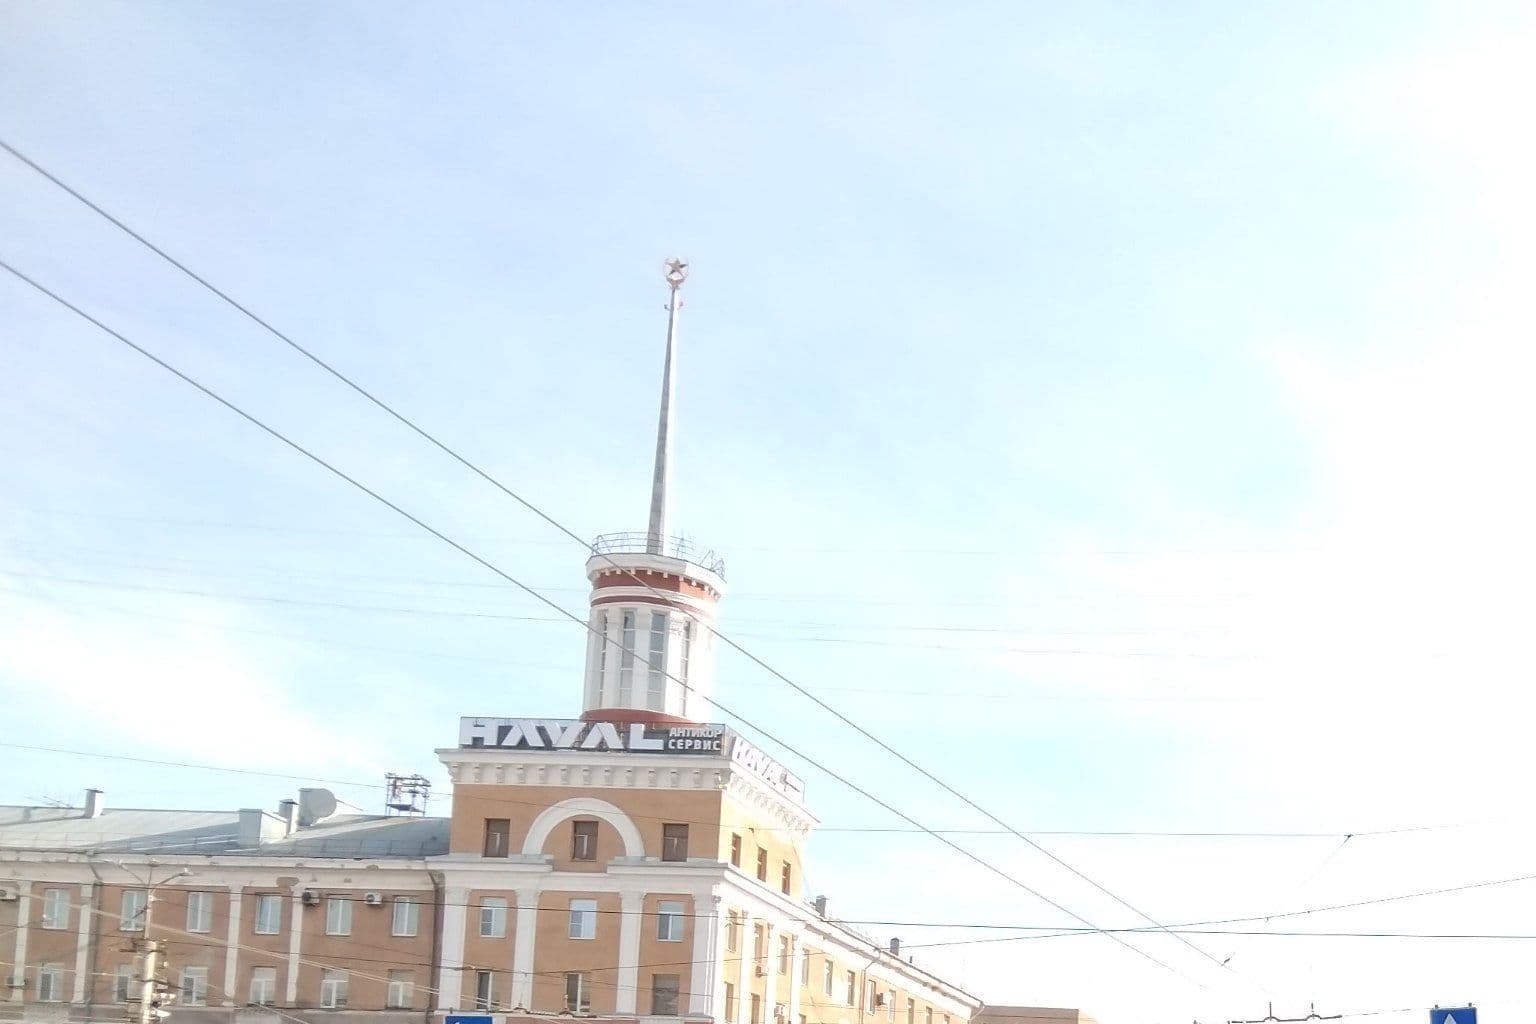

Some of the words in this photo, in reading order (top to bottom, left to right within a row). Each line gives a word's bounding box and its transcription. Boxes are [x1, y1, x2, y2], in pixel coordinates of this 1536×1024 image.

[459, 719, 664, 750] HAVAL
[669, 727, 722, 738] АНТИКОР
[668, 739, 721, 750] СЕРВИС
